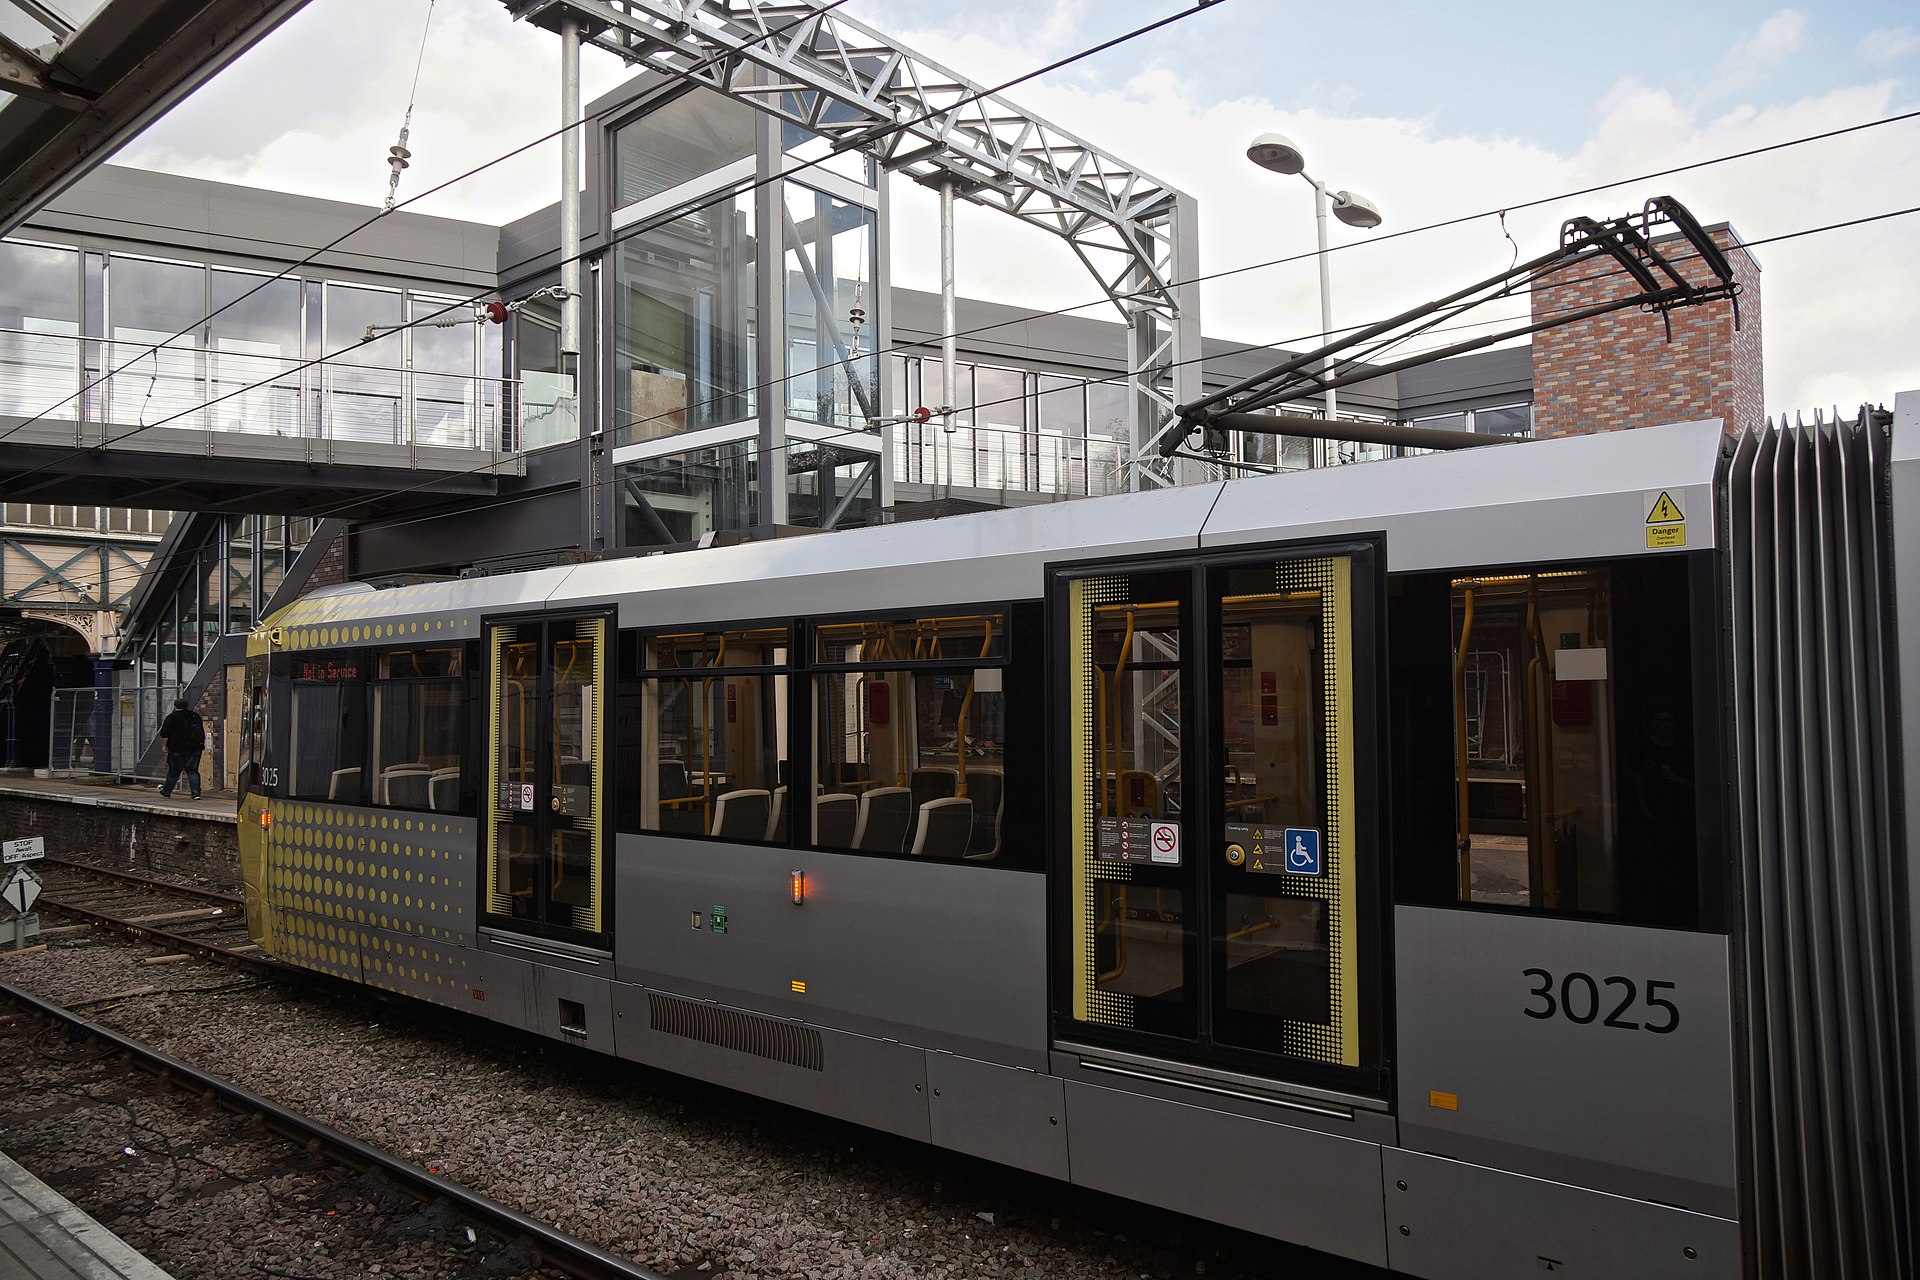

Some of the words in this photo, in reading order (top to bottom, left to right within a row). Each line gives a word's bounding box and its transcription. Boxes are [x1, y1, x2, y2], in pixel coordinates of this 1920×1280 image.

[303, 662, 315, 679] Not
[318, 664, 325, 679] in
[327, 661, 357, 678] Service
[261, 766, 278, 786] 3025
[14, 839, 33, 847] STOP
[1522, 968, 1680, 1034] 3025
